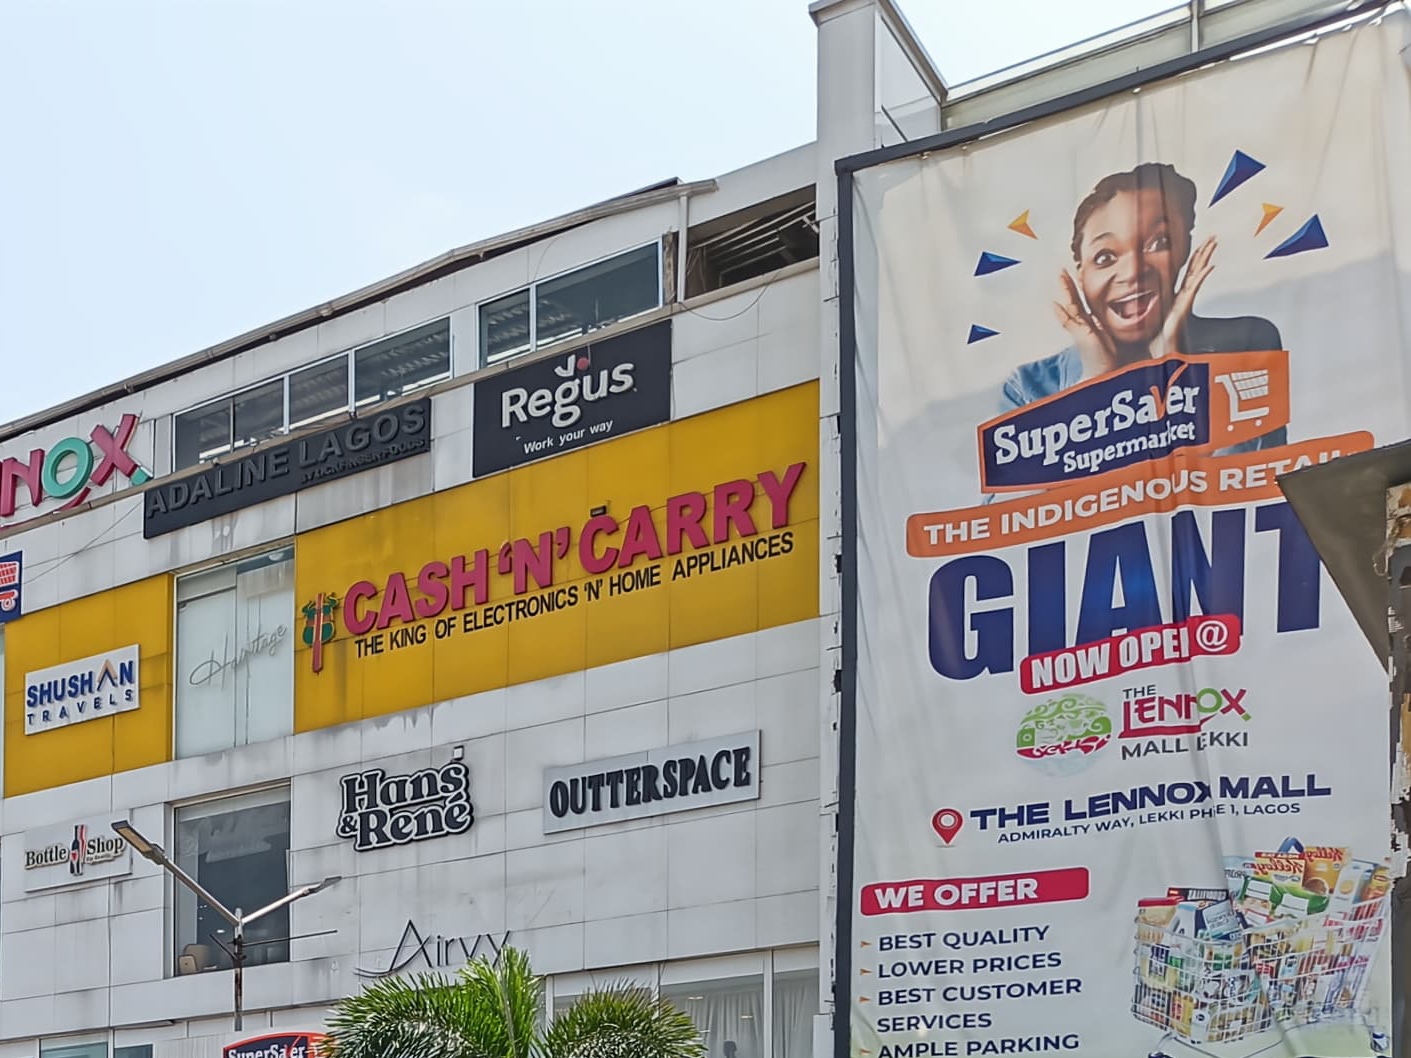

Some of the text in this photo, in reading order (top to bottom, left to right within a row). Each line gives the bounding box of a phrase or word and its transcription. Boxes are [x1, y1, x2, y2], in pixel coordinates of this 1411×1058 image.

[502, 356, 635, 428] Regus
[994, 364, 1200, 466] SuperSaver
[524, 420, 614, 454] Work your way
[1064, 421, 1195, 473] Supermarket
[147, 450, 289, 518] ADALINE
[299, 405, 426, 468] LAGOS
[924, 518, 991, 546] THE
[1001, 470, 1208, 536] INDIGENOUS
[343, 549, 489, 635] CASH
[579, 461, 807, 574] CARRY
[355, 634, 384, 659] THE
[390, 624, 426, 651] KING
[435, 616, 457, 639] OF
[463, 585, 578, 635] ELECTRONICS
[610, 565, 662, 596] HOME
[672, 531, 794, 582] APPLIANCES
[928, 501, 1323, 682] GIANT
[1030, 642, 1110, 689] NOW
[27, 689, 134, 726] TRAVELS
[1122, 684, 1156, 699] THE
[1121, 738, 1189, 761] MALL
[549, 746, 751, 818] OUTTERSPACE
[971, 802, 1050, 831] THE
[1219, 773, 1332, 800] MALL
[998, 825, 1090, 844] ADMIRALTY
[1096, 817, 1136, 834] WAY,
[1139, 809, 1184, 824] LEKKI
[1243, 802, 1300, 817] LAGOS
[25, 837, 124, 867] Bottle Shop
[874, 878, 1039, 909] WE OFFER
[879, 925, 1050, 952] BEST QUALITY
[878, 951, 1062, 979] LOWER PRICES
[878, 978, 1082, 1006] BEST CUSTOMER
[877, 1013, 992, 1033] SERVICES
[966, 1034, 1080, 1056] PARKING
